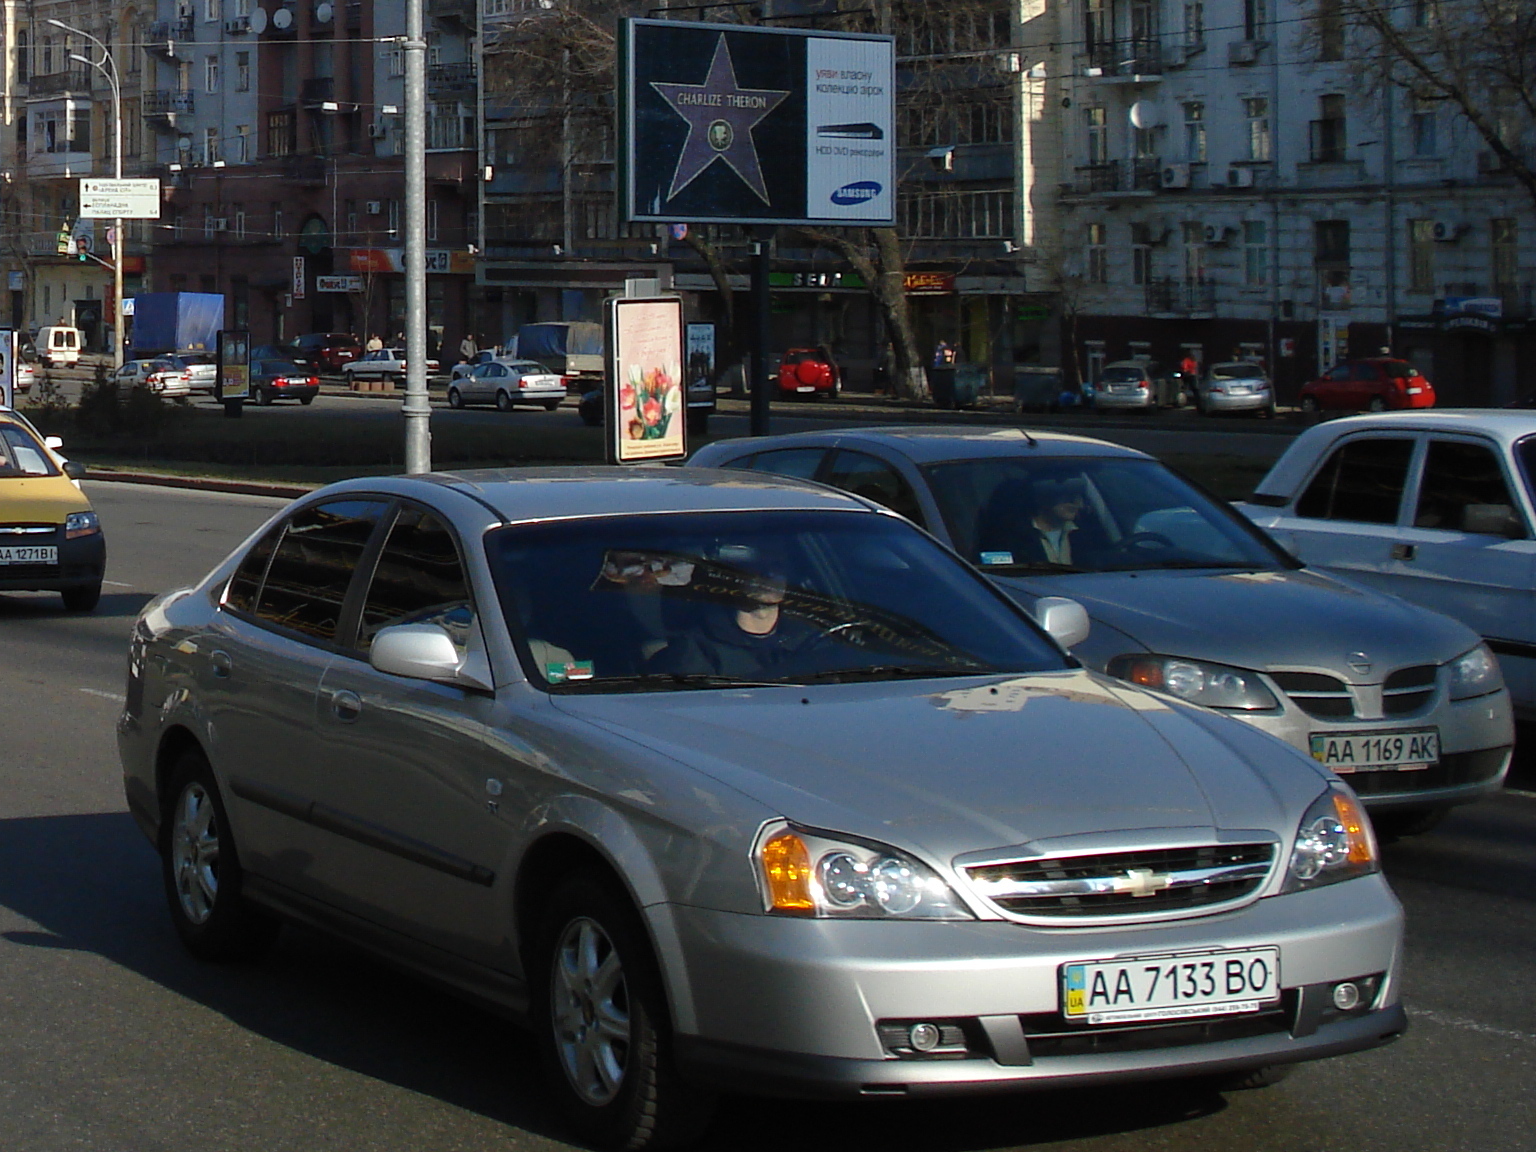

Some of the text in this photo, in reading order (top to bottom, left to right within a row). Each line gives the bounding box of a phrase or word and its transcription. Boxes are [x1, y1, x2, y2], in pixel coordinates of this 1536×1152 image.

[677, 92, 766, 109] CHARLIZE THERON
[1326, 735, 1434, 763] AA 1169 AK
[1089, 958, 1268, 1006] AA 7133 BO
[1070, 997, 1084, 1008] UA
